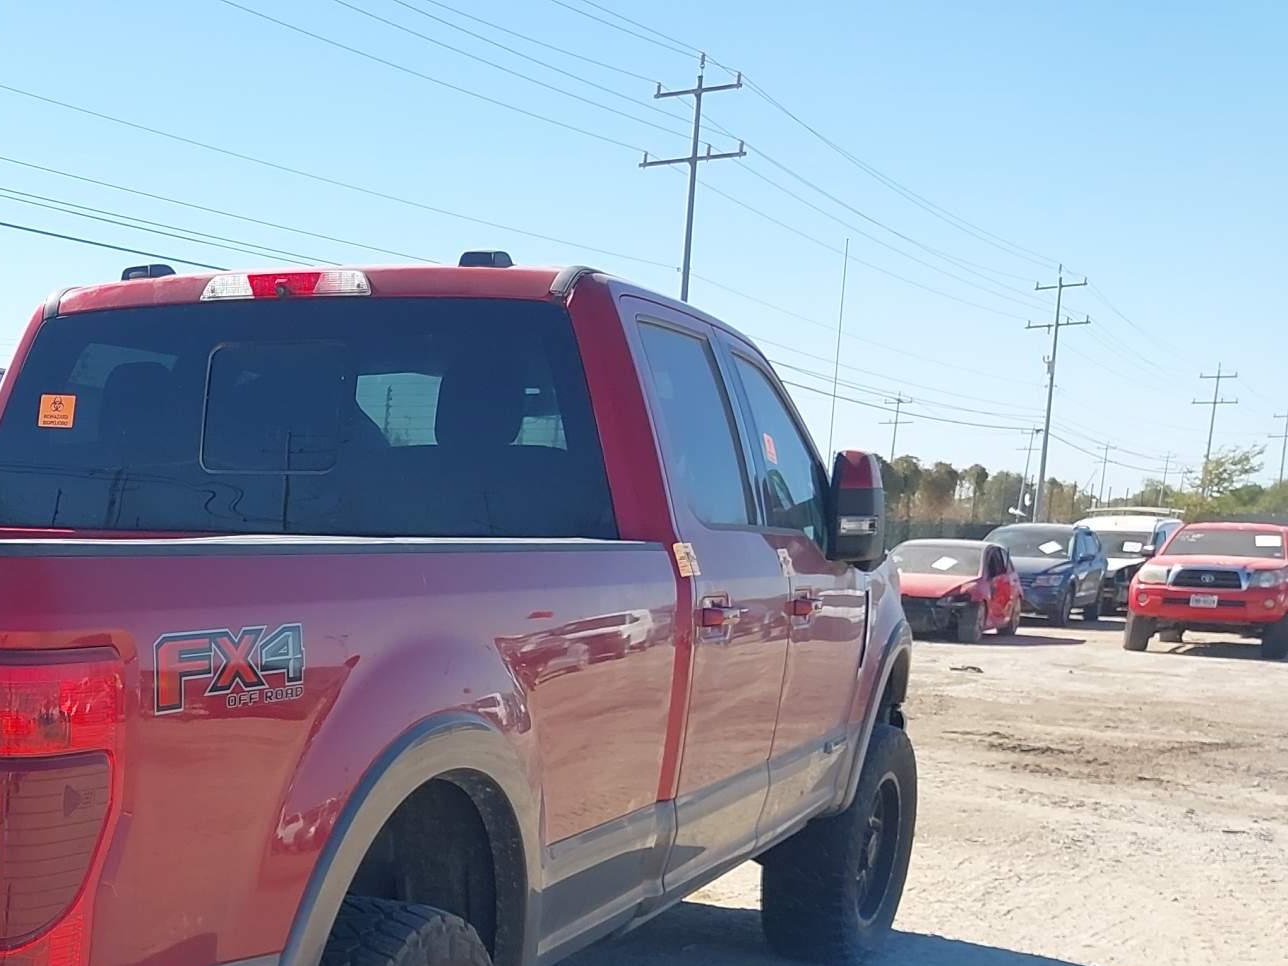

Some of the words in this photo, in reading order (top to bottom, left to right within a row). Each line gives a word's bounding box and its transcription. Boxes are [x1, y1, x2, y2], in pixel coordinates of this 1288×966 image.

[153, 622, 306, 715] FX4
[226, 691, 259, 709] OFF
[263, 684, 305, 703] ROAD
